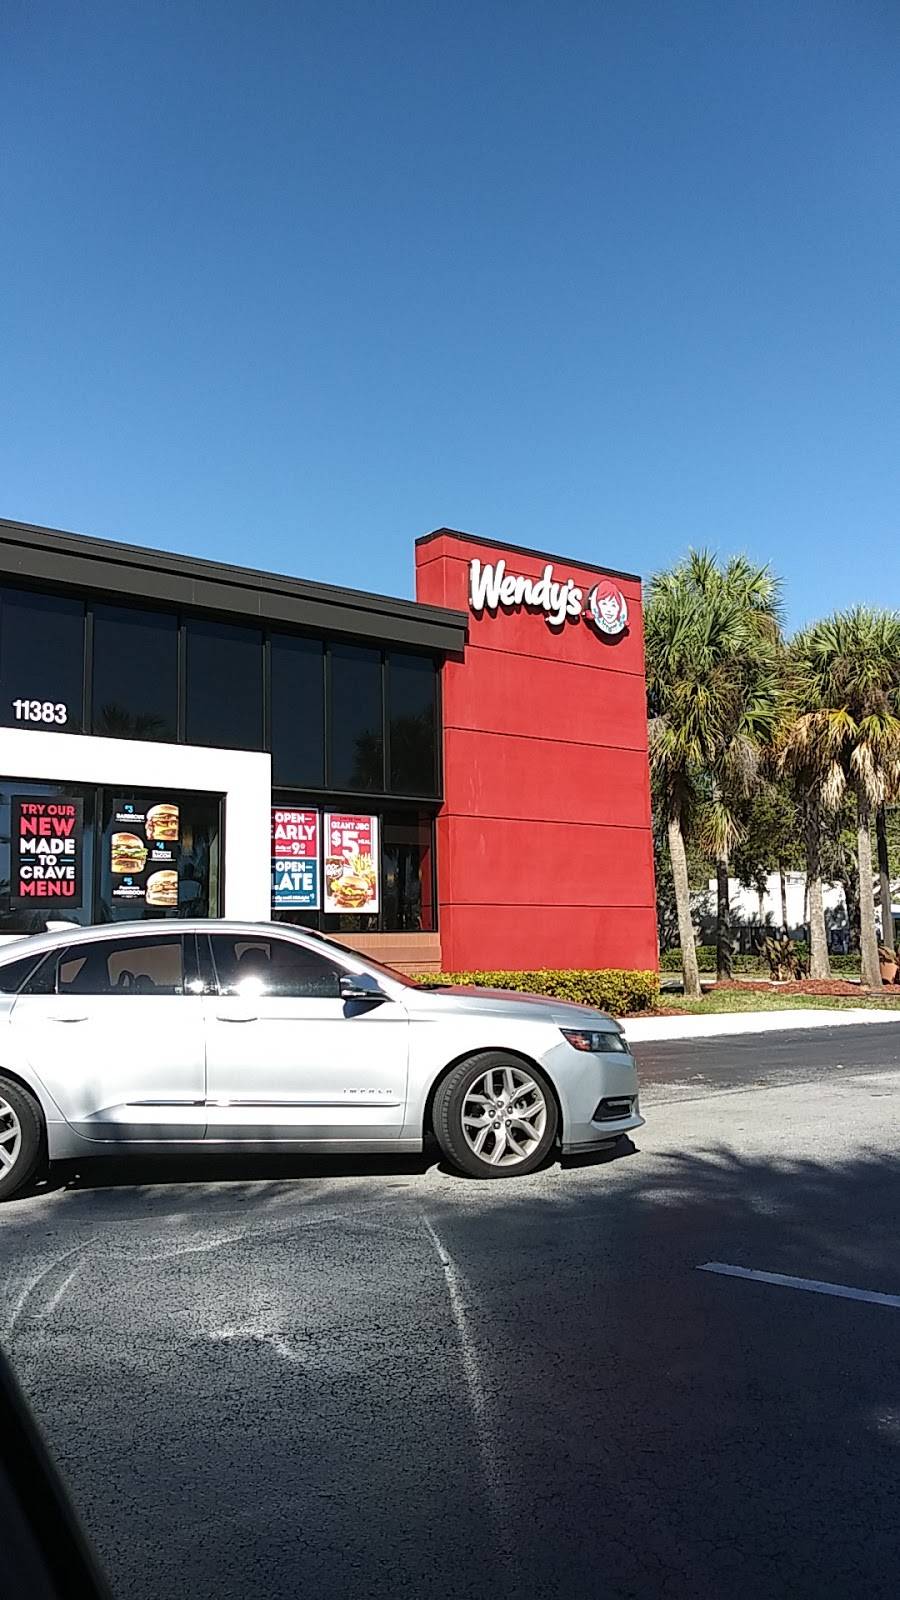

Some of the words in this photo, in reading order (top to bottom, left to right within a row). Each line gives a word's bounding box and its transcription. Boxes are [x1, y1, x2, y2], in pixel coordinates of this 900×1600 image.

[469, 558, 583, 625] Wendy's
[12, 699, 67, 724] 11383
[20, 803, 45, 815] TRY
[47, 804, 75, 816] OUR
[20, 817, 75, 837] NEW
[331, 821, 355, 830] GIANT
[355, 823, 370, 831] JBC
[20, 838, 75, 855] MADE
[331, 830, 360, 858] $5
[38, 854, 57, 866] TO
[19, 866, 75, 880] CRAVE
[20, 880, 75, 897] MENU
